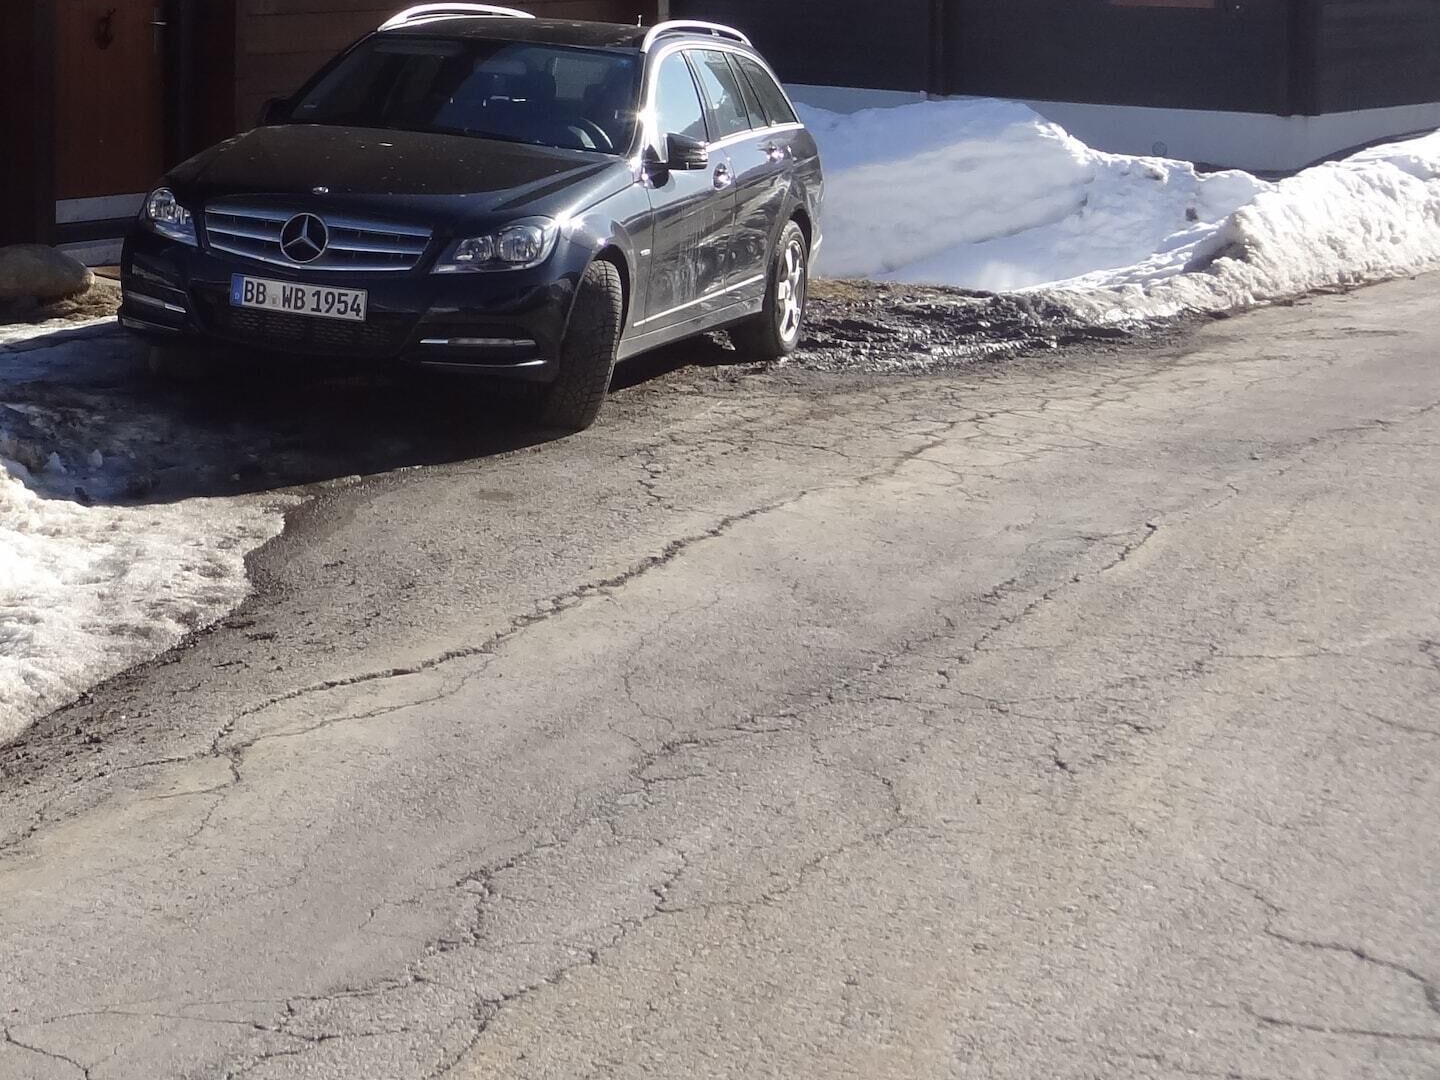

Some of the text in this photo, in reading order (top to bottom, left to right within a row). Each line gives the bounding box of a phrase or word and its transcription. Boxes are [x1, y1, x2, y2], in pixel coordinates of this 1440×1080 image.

[243, 280, 267, 305] BB
[282, 285, 306, 310] WB
[310, 290, 362, 317] 1954
